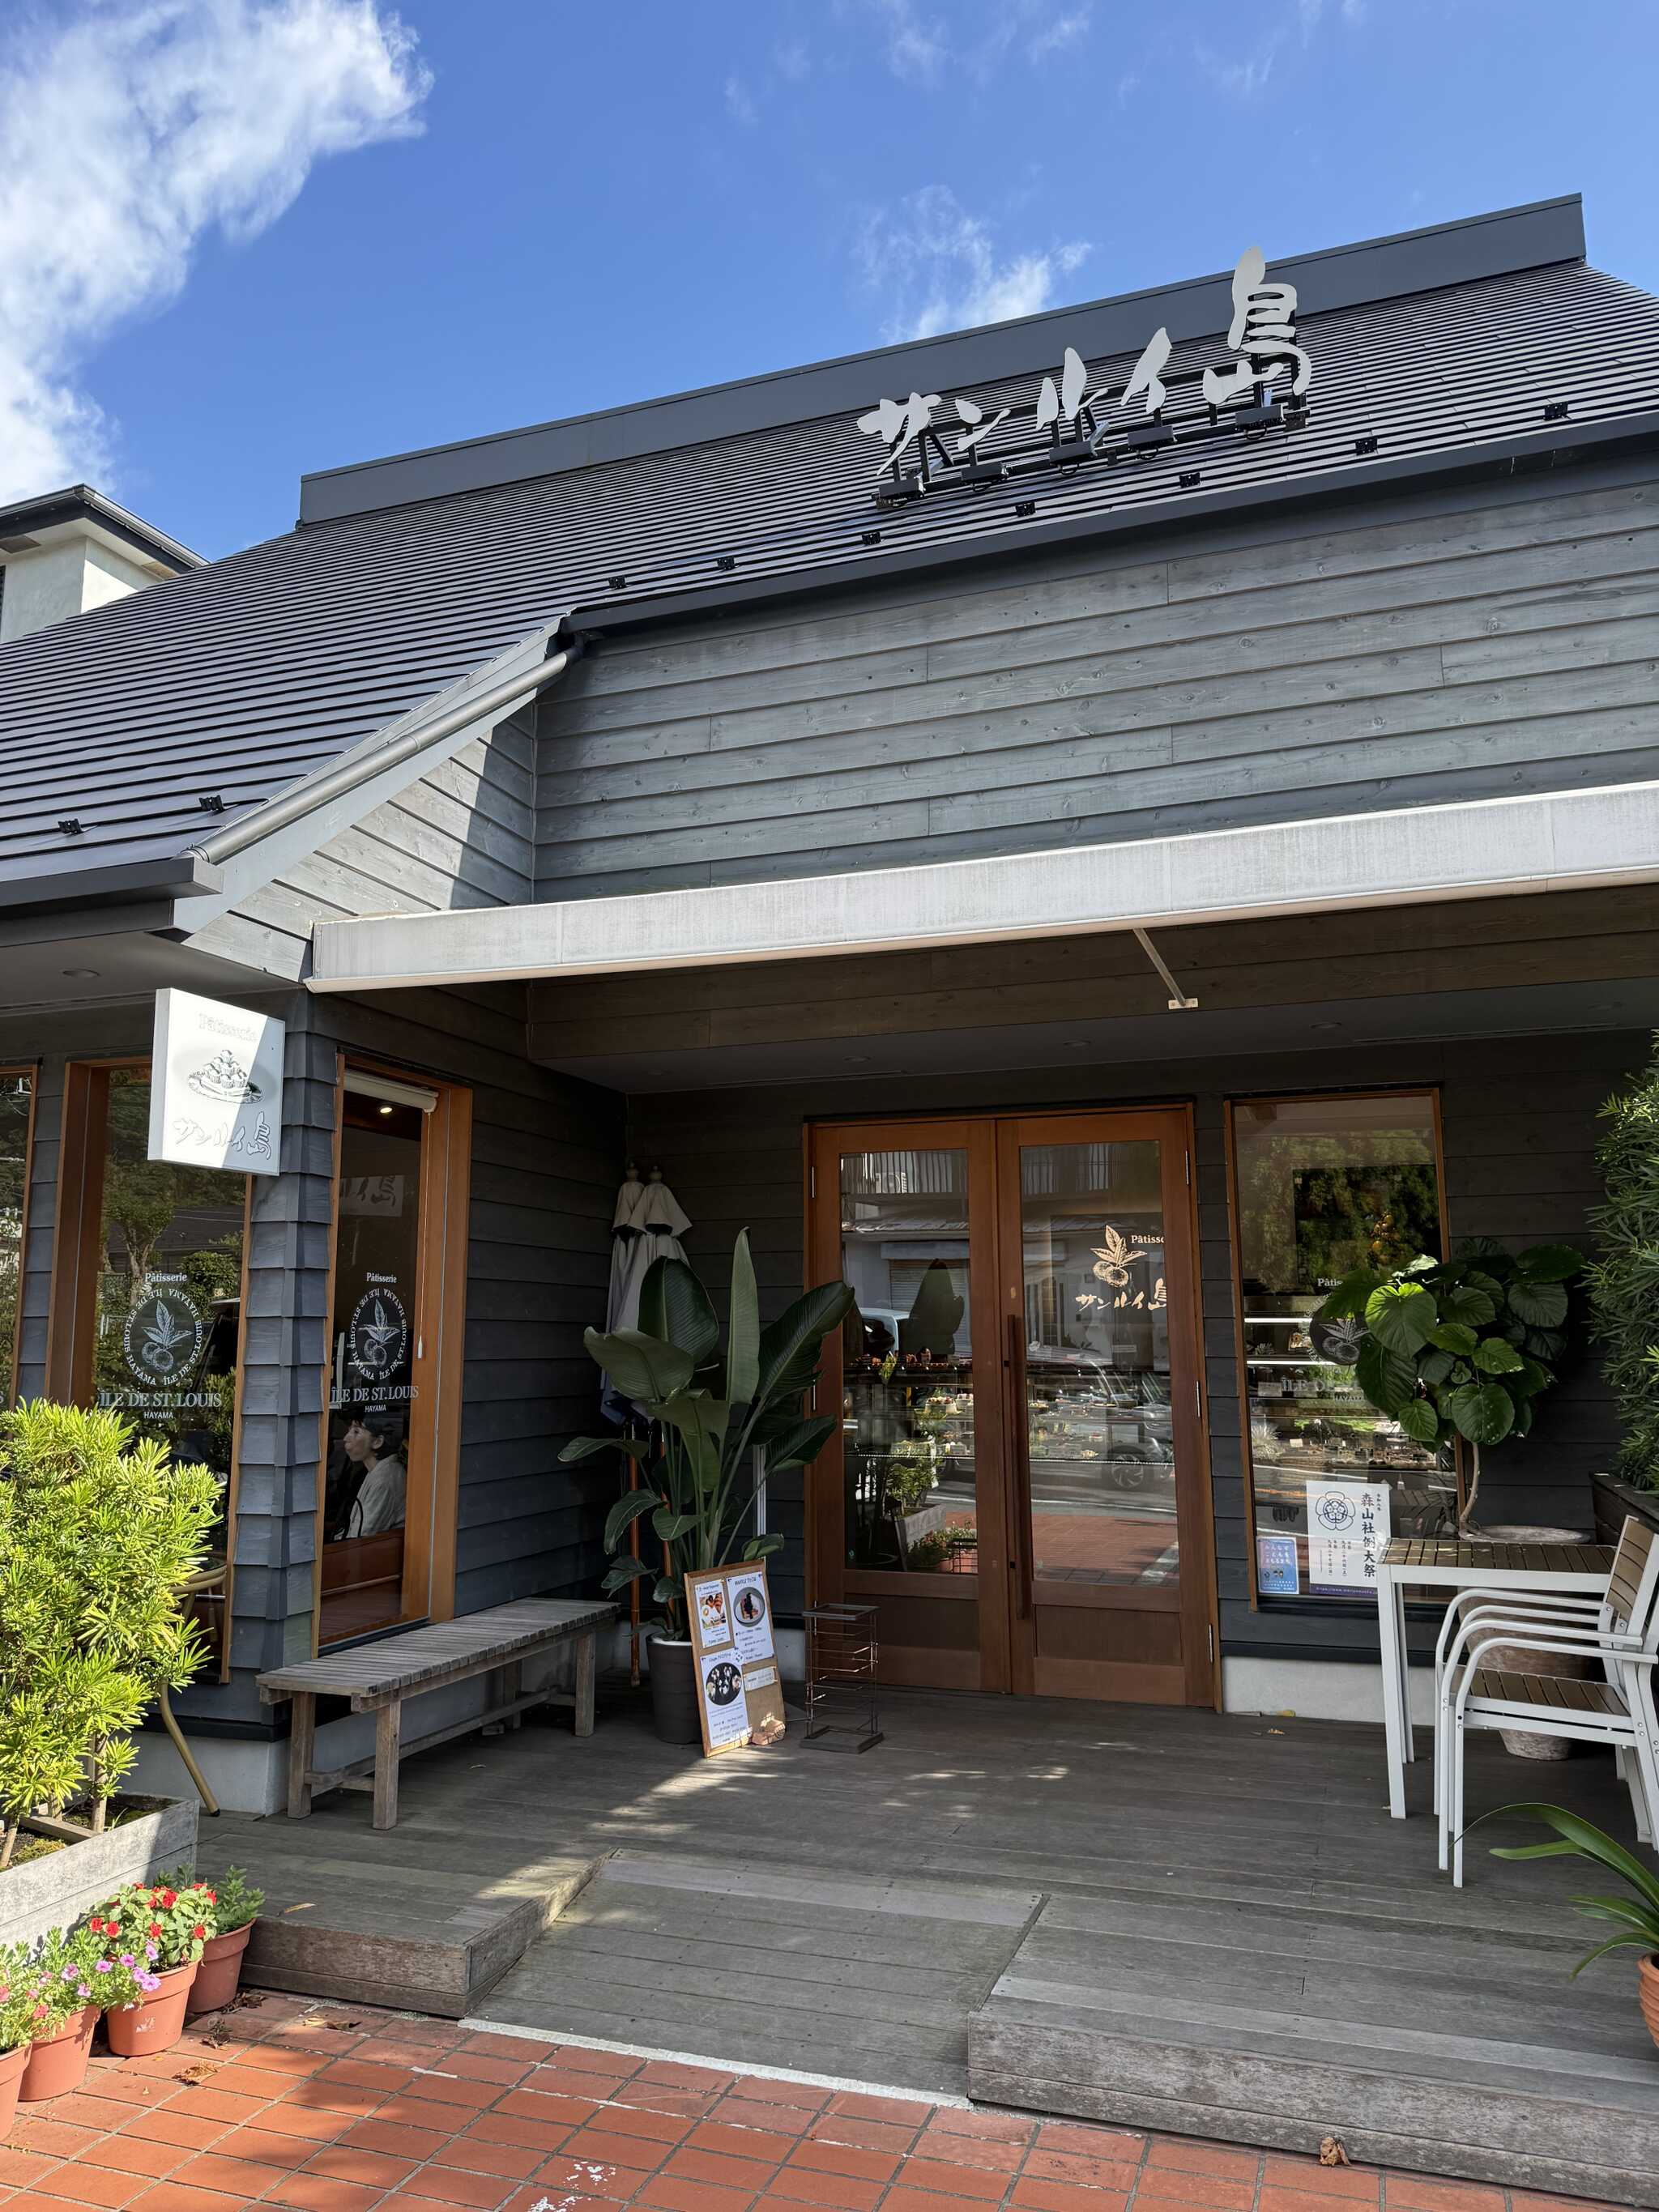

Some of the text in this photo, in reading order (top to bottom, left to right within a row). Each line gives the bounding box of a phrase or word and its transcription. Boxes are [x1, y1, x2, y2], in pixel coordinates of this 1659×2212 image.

[856, 245, 1312, 475] サンルイ島
[172, 1110, 272, 1161] サンルイ島
[144, 1272, 188, 1282] Pâtisserie
[366, 1272, 398, 1283] Pâtisserie
[1317, 1277, 1343, 1287] Pâtis
[127, 1392, 150, 1407] DE
[353, 1387, 370, 1402] DE
[144, 1411, 173, 1419] HAYAMA
[365, 1404, 386, 1413] HAYAMA
[1361, 1492, 1376, 1578] 森山社例大祭
